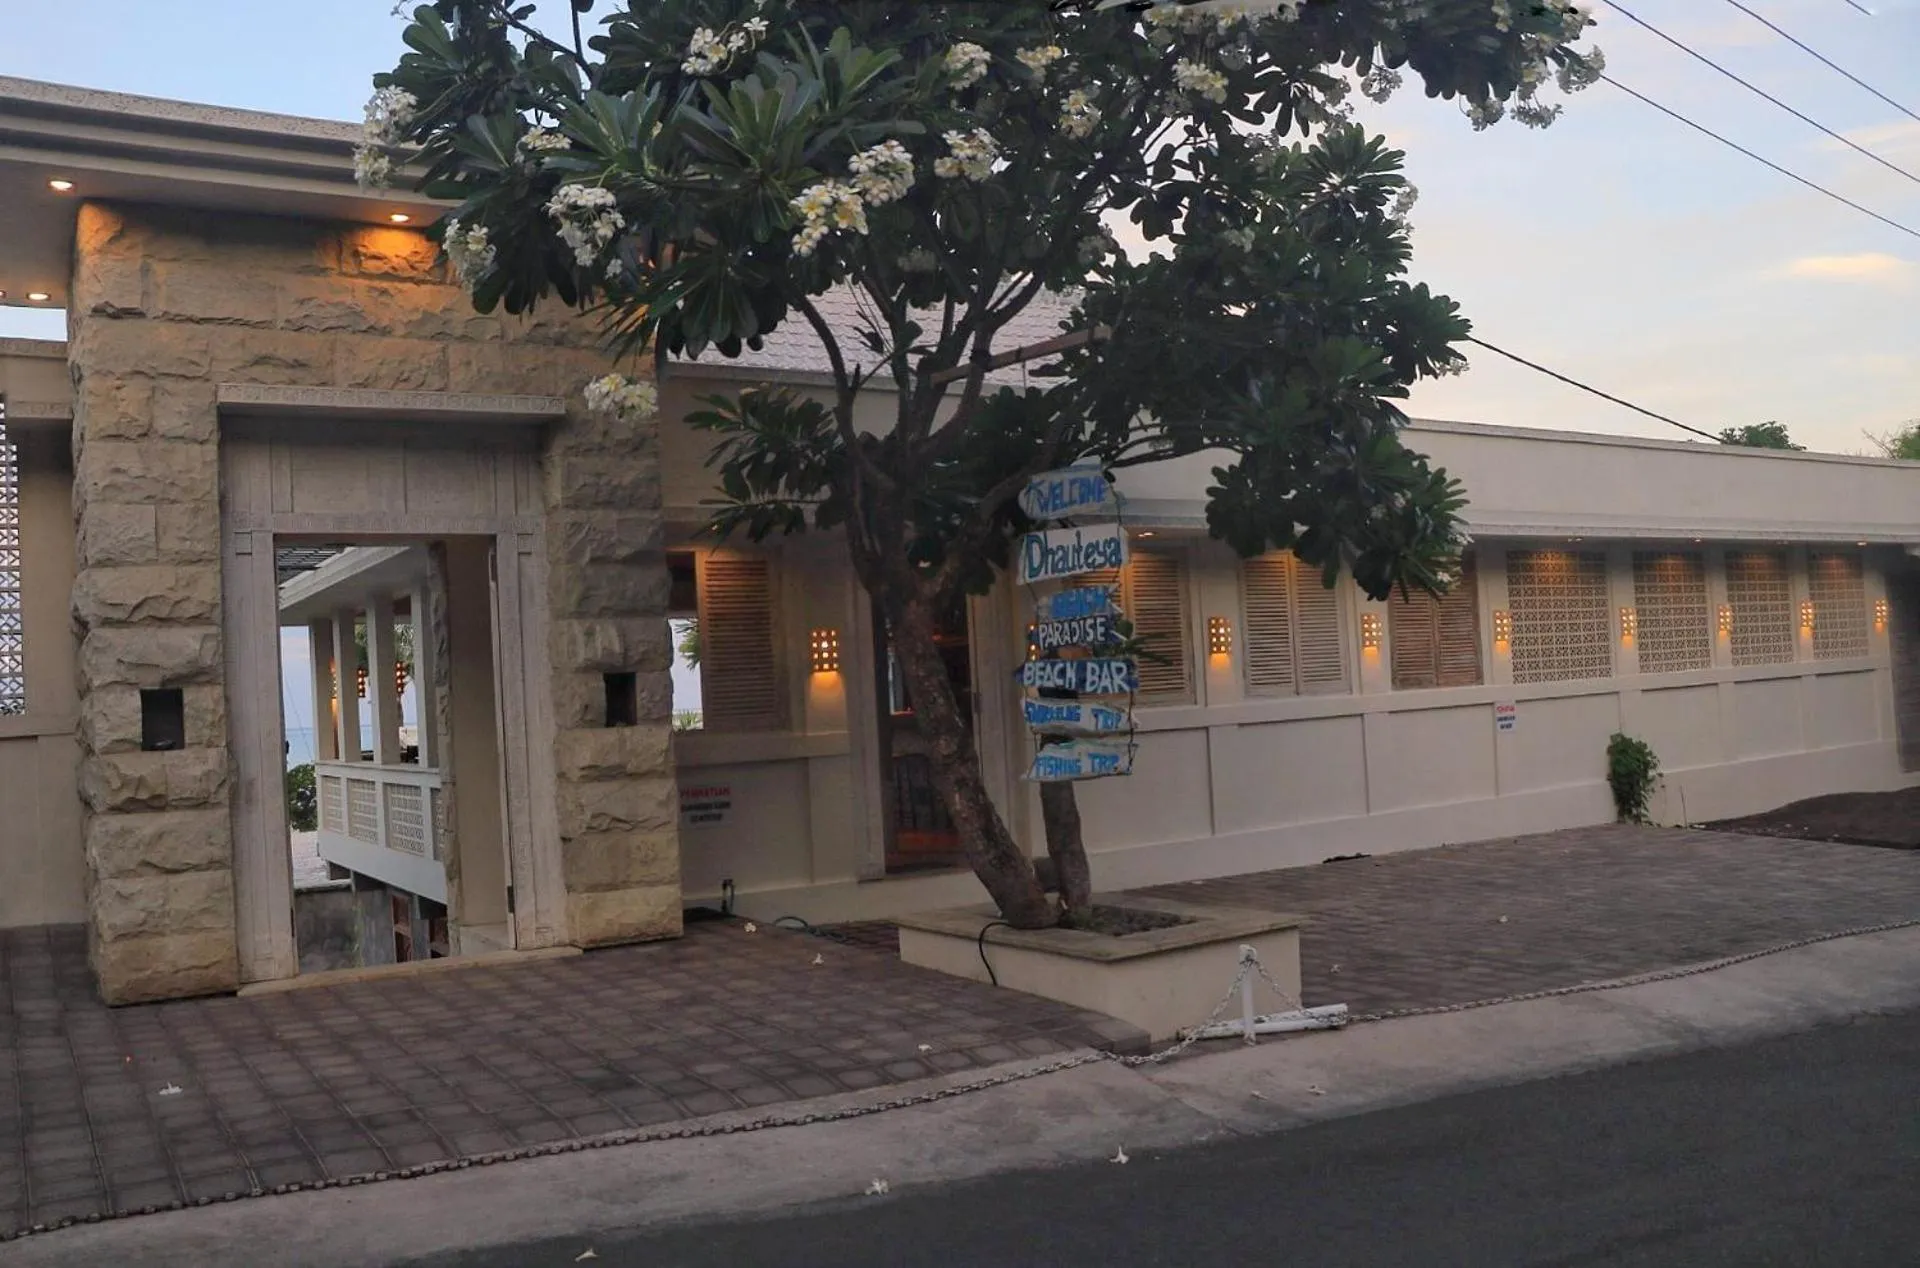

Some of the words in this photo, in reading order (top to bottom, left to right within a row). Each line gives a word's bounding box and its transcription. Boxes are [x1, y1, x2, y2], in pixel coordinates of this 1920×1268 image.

[1036, 475, 1107, 513] WELCOME
[1039, 616, 1106, 650] PARADISE
[1023, 661, 1077, 690] BEACH
[1085, 661, 1131, 693] BAR
[1091, 707, 1123, 730] TRIP
[1034, 754, 1082, 778] FISHING
[1087, 752, 1121, 774] TRIP
